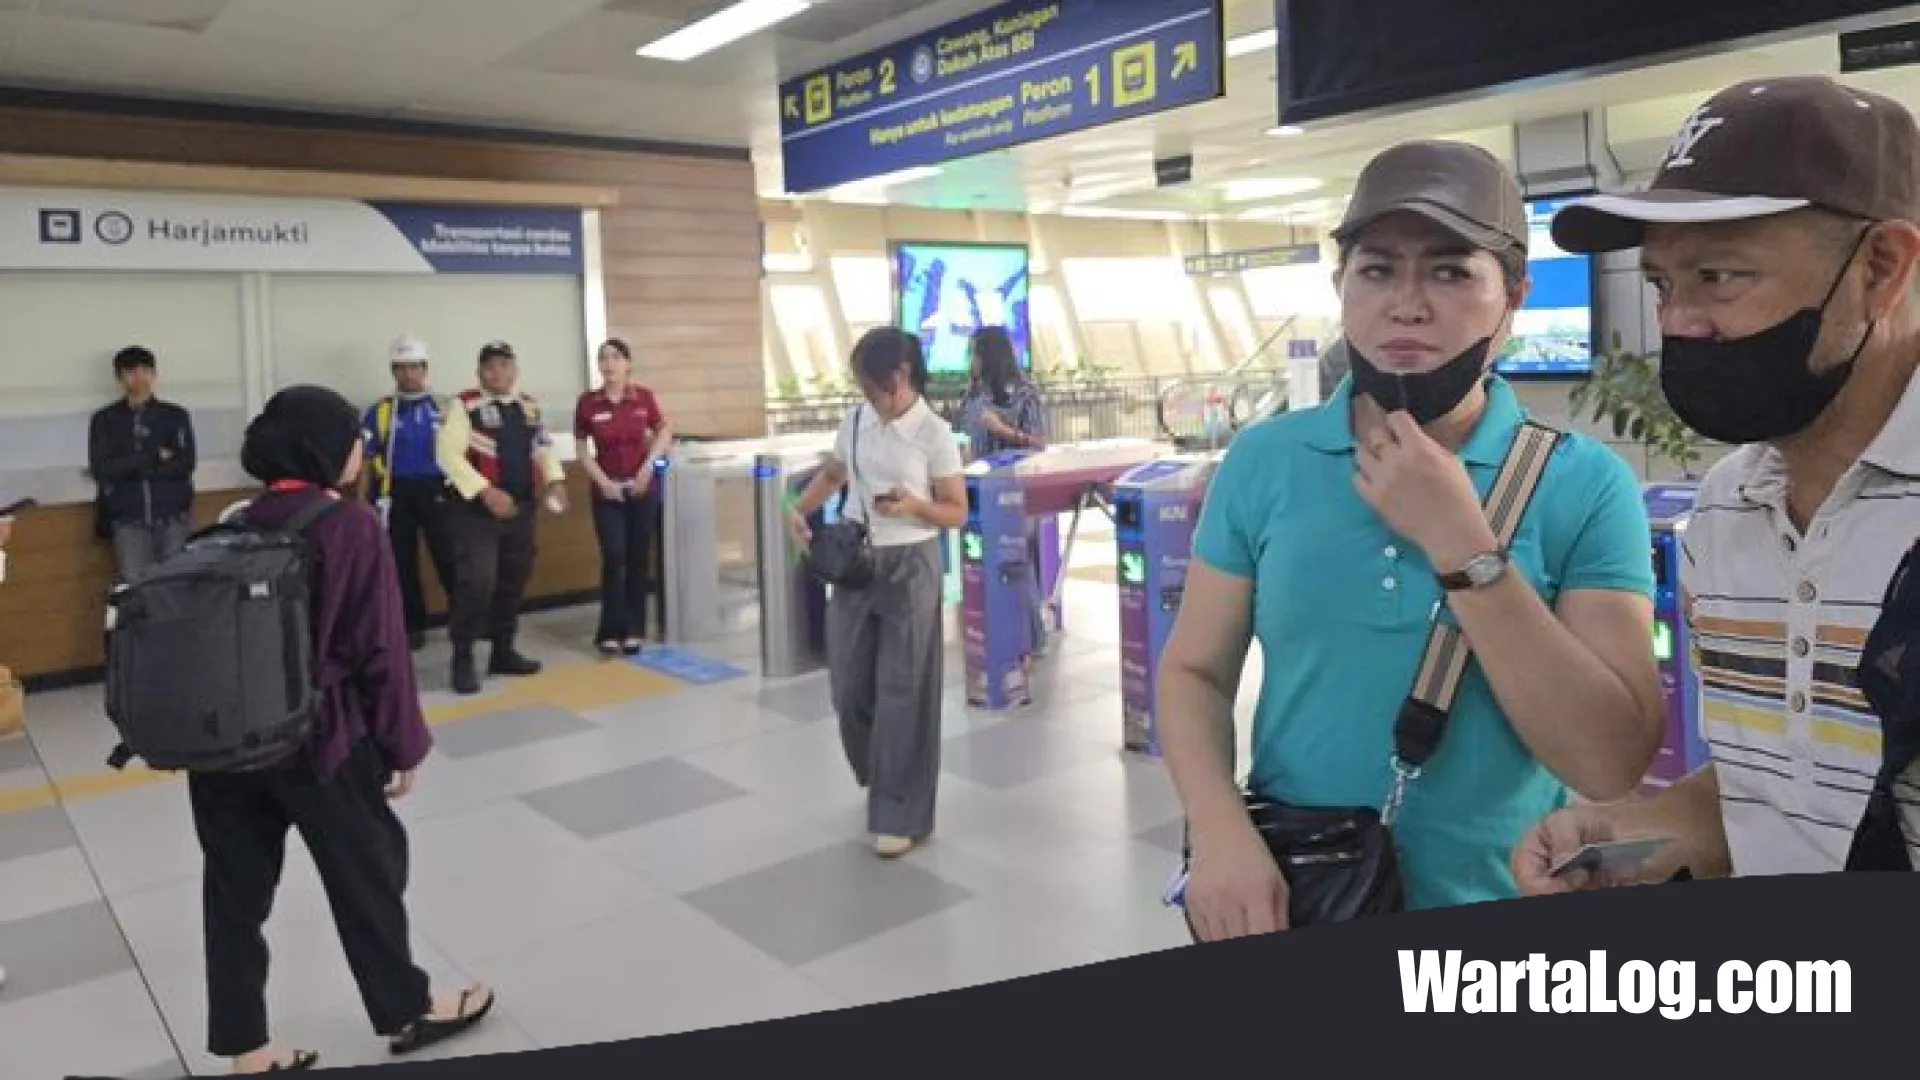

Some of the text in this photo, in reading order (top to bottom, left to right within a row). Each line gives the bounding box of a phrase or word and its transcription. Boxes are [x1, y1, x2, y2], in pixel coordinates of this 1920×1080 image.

[993, 4, 1058, 35] Kuningan
[836, 57, 897, 95] Peron 2
[1020, 65, 1100, 106] Peron 1
[905, 113, 940, 136] untuk
[1021, 102, 1073, 128] Platform
[147, 217, 309, 247] Harjamukti
